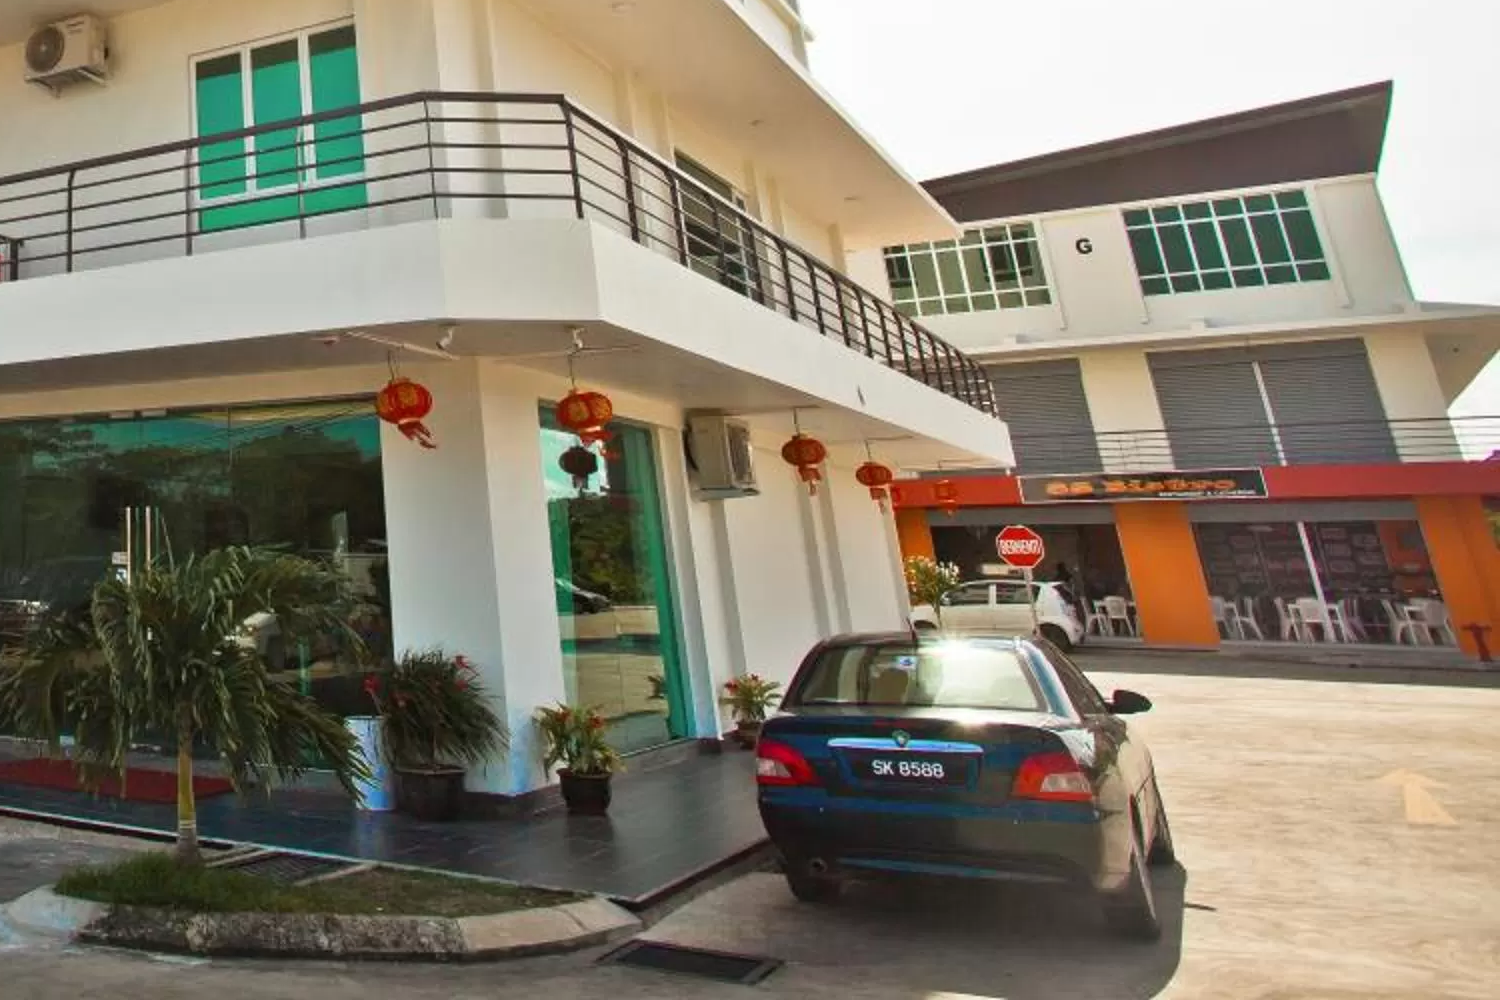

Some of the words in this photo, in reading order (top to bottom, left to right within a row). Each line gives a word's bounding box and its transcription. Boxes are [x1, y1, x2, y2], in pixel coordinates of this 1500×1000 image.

[1076, 238, 1092, 254] G
[872, 759, 895, 776] SK
[898, 761, 945, 779] 8588
